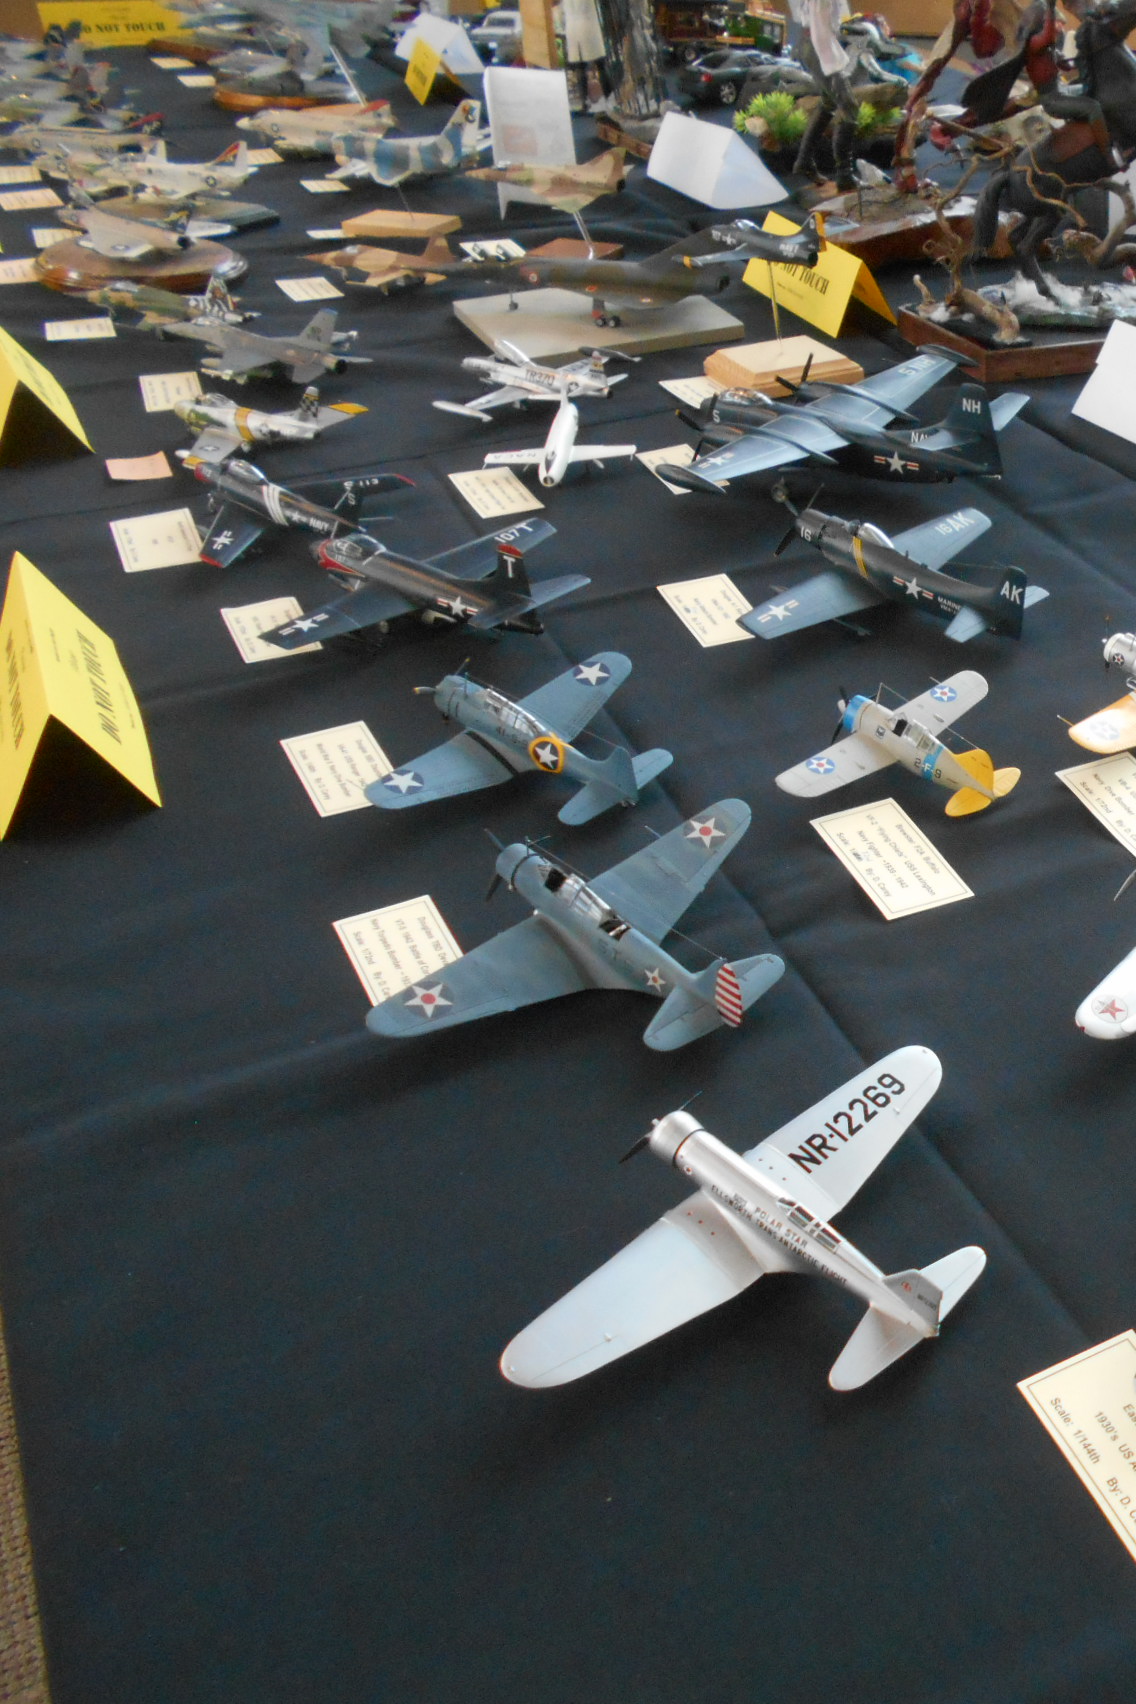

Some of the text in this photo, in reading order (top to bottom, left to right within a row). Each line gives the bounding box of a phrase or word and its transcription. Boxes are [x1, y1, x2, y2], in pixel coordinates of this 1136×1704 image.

[95, 24, 120, 33] NOT
[126, 22, 166, 32] TOUCH
[799, 267, 830, 295] TOUCH
[962, 399, 982, 414] NH
[494, 522, 534, 544] 107T
[800, 526, 812, 542] 16
[935, 511, 976, 536] 16 AK
[503, 555, 517, 578] T
[1000, 580, 1023, 604] AK
[865, 841, 883, 858] Fighter
[912, 871, 936, 896] Lexington
[755, 1207, 809, 1249] POLAR STAR
[1094, 1411, 1119, 1442] 1930's
[1118, 1443, 1135, 1460] US
[1050, 1397, 1075, 1426] Scale:
[1073, 1429, 1101, 1464] 1/144th
[1106, 1477, 1122, 1497] By:
[1120, 1495, 1132, 1511] D.
